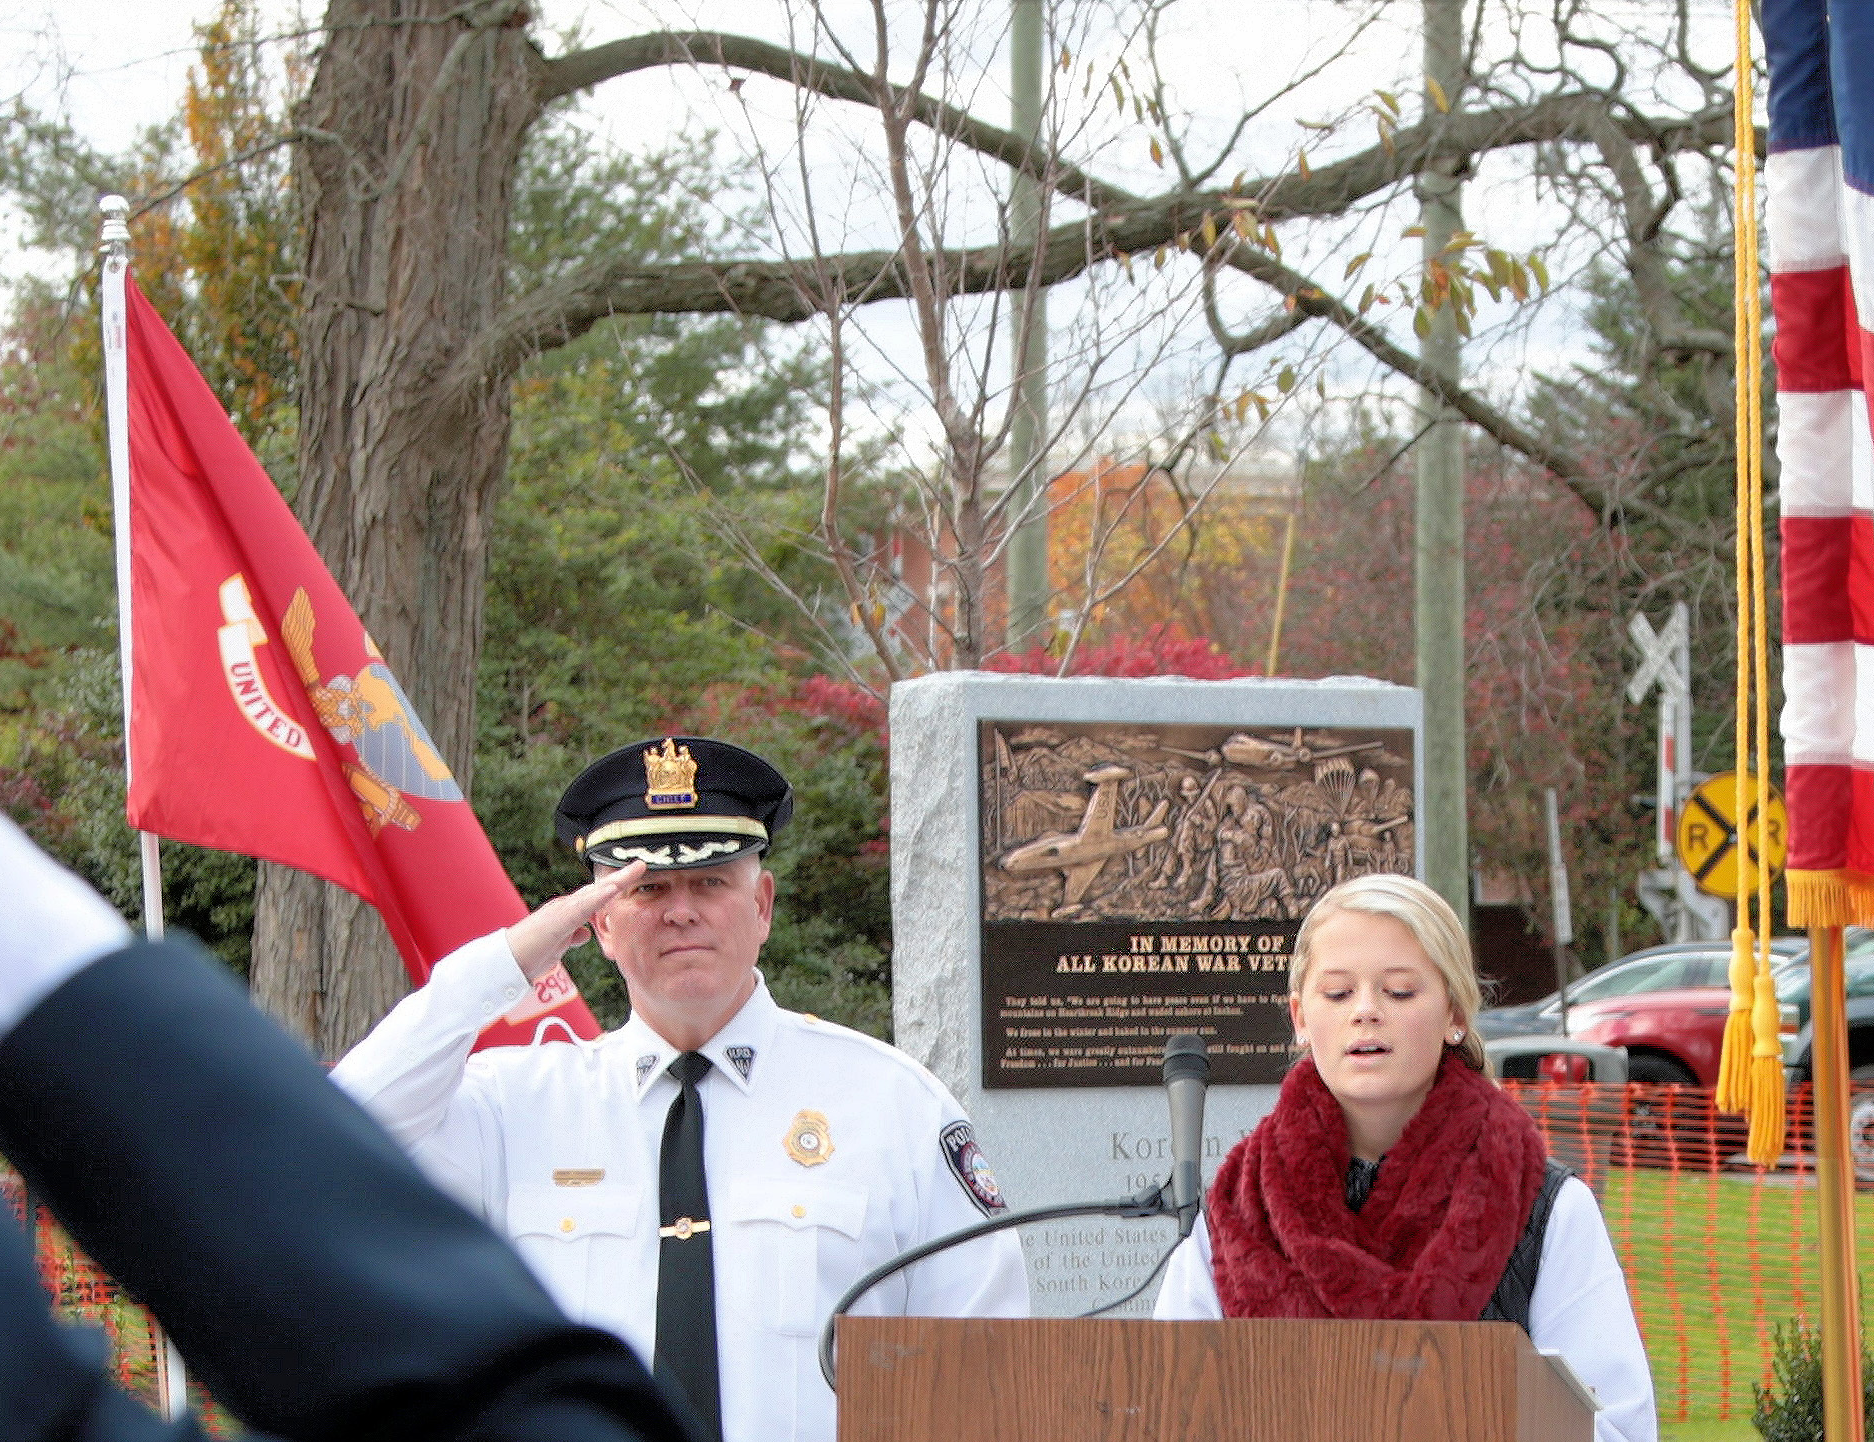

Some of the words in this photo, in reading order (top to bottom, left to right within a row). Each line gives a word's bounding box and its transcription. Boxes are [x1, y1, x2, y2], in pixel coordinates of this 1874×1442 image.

[230, 660, 302, 748] UNITED
[1688, 822, 1710, 850] R
[1129, 935, 1154, 953] IN
[1160, 935, 1251, 953] MEMORY
[1257, 935, 1284, 953] OF
[1056, 954, 1096, 973] ALL
[1102, 954, 1189, 973] KOREAN
[1195, 954, 1241, 972] WAR
[1005, 996, 1027, 1008] They
[1103, 995, 1127, 1007] going
[1111, 1132, 1222, 1161] Korn
[1044, 1228, 1105, 1246] United
[1115, 1227, 1168, 1244] States
[1034, 1253, 1053, 1270] of
[1063, 1252, 1090, 1269] the
[1099, 1250, 1161, 1269] United
[1035, 1275, 1088, 1293] South
